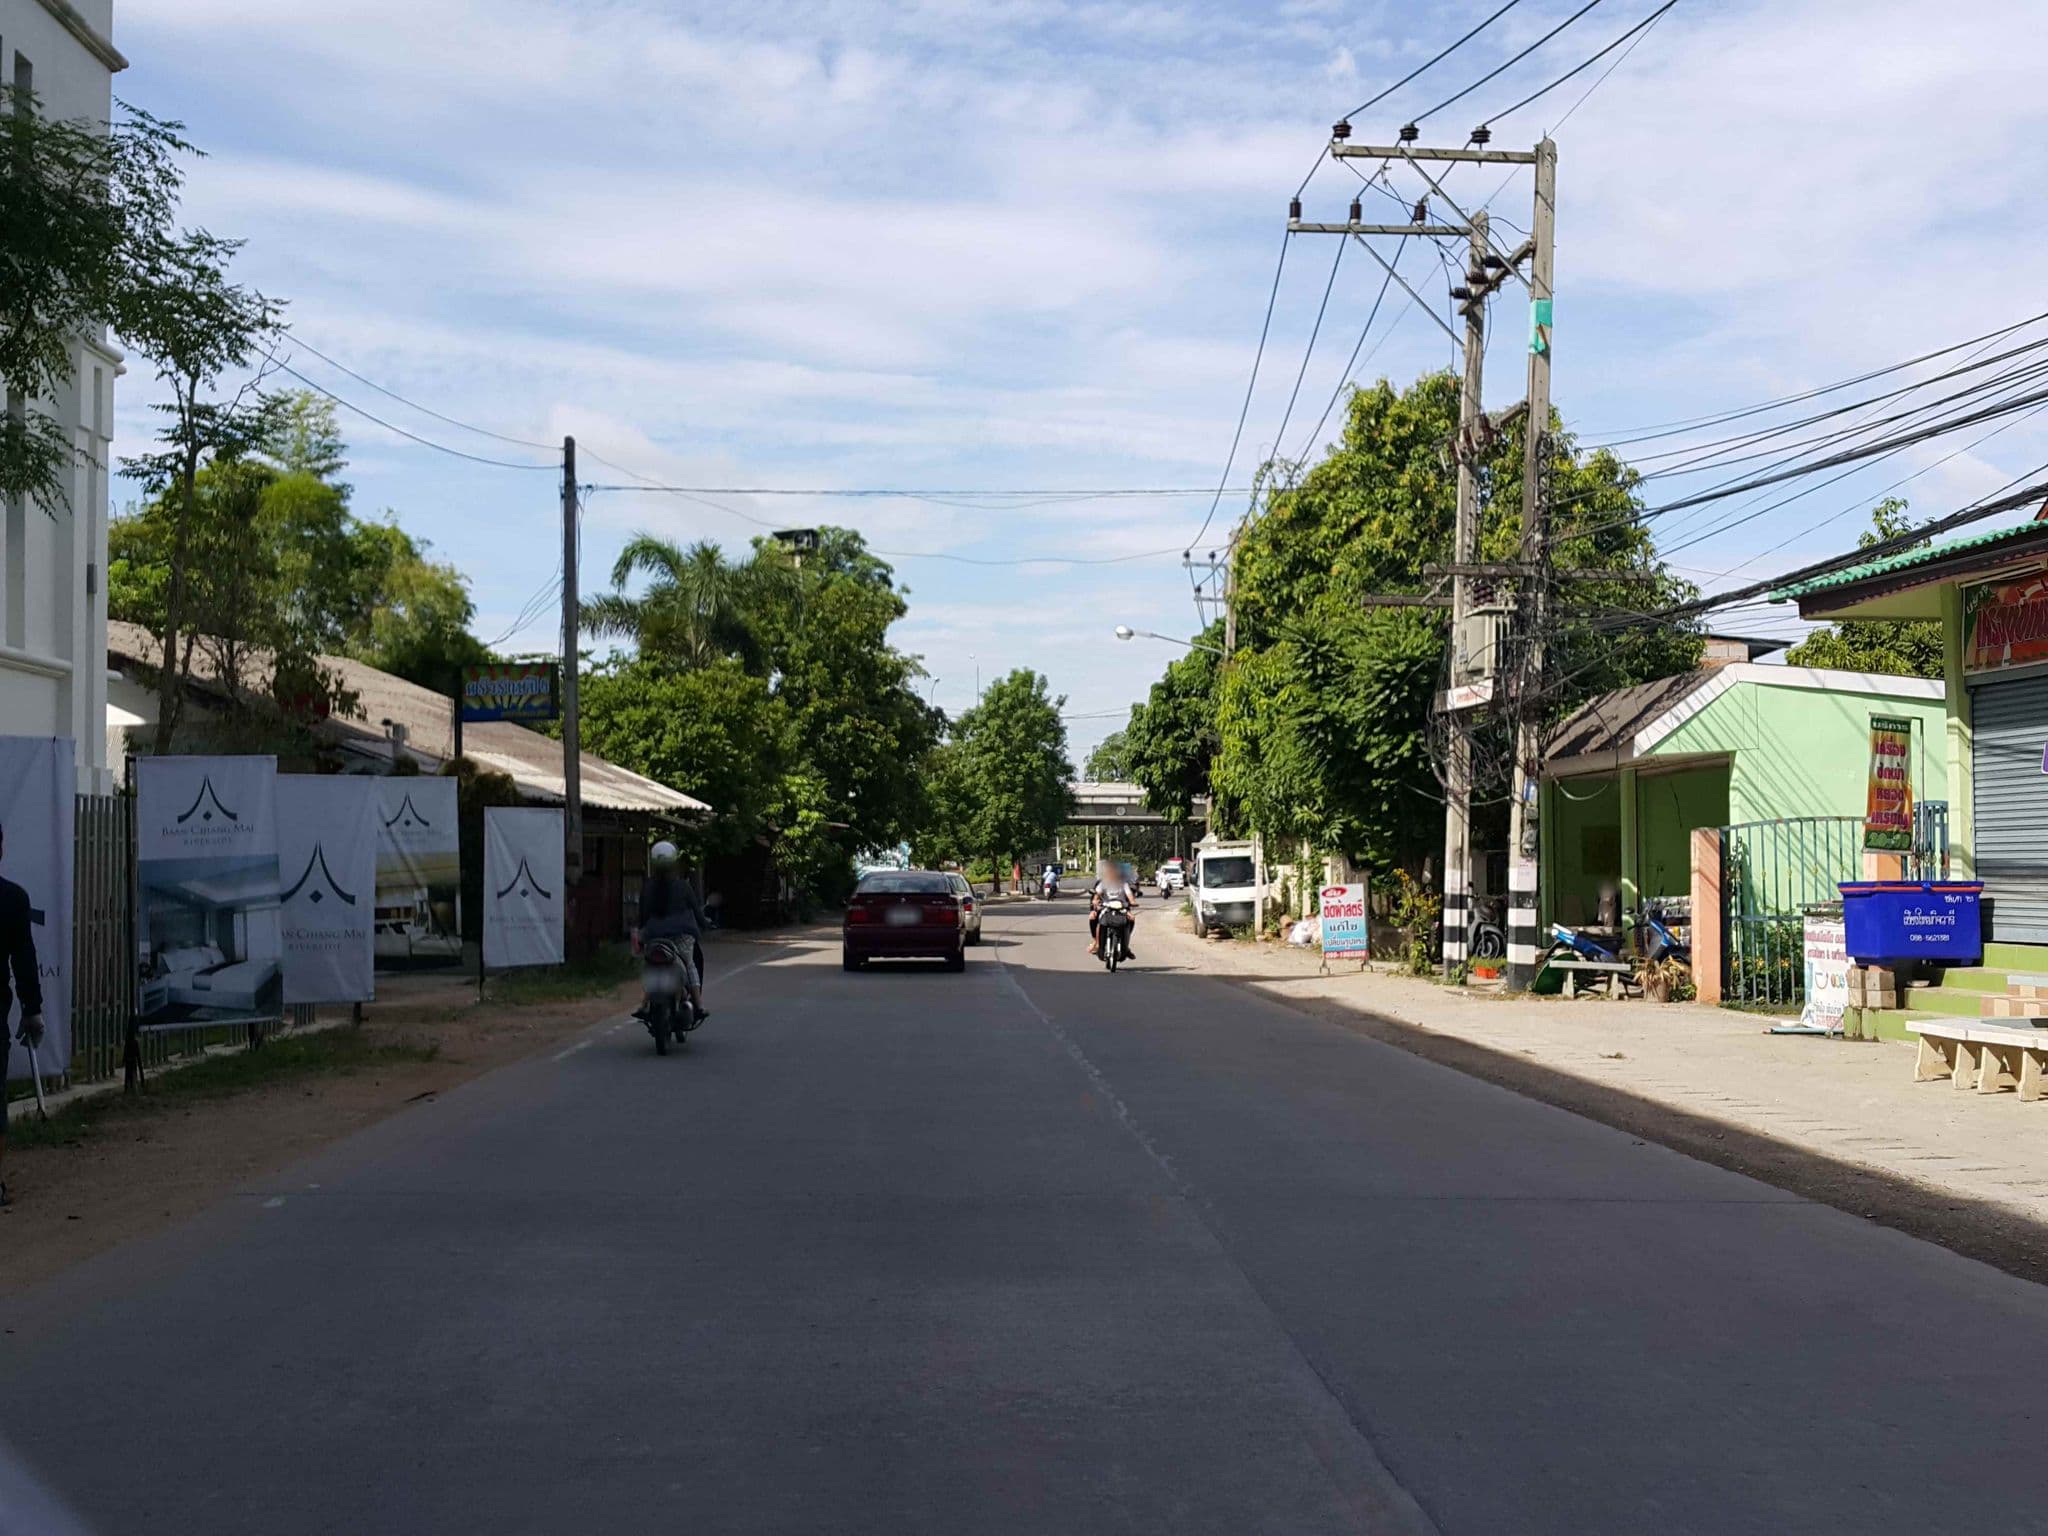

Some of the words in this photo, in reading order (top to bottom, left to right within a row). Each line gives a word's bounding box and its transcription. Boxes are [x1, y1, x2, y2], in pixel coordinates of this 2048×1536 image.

[1876, 787, 1905, 802] หยอด
[1323, 899, 1364, 919] ตัดผ้าสตรี
[1329, 920, 1358, 932] แก้ไข
